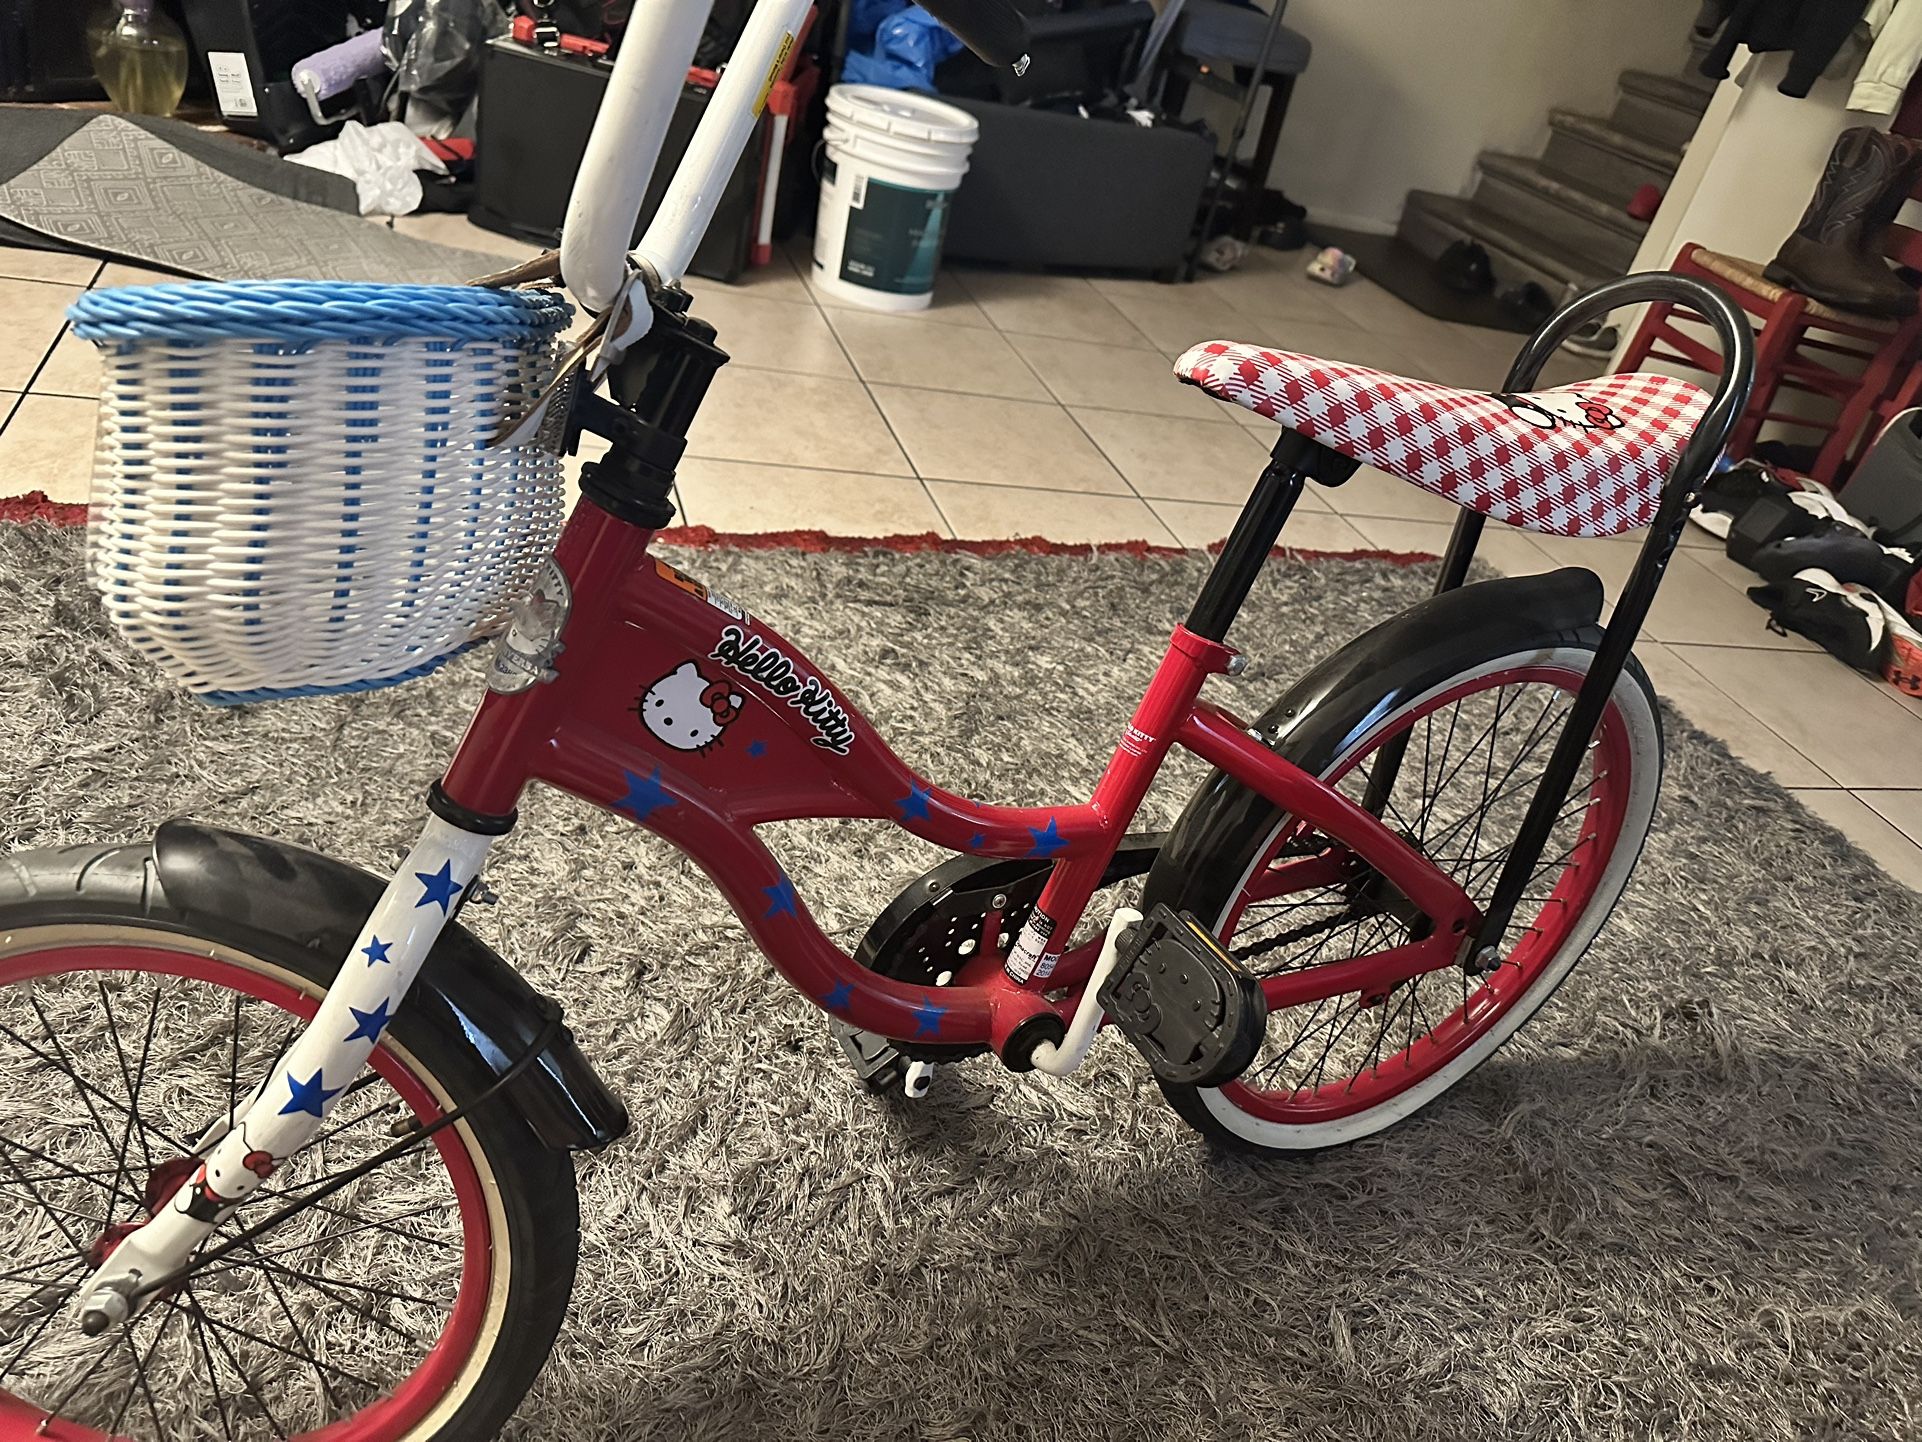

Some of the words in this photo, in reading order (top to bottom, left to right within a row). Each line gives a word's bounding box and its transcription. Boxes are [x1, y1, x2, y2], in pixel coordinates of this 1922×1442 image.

[709, 626, 802, 697] Hello
[788, 677, 854, 754] Kitty
[1014, 941, 1039, 960] ynacraft
